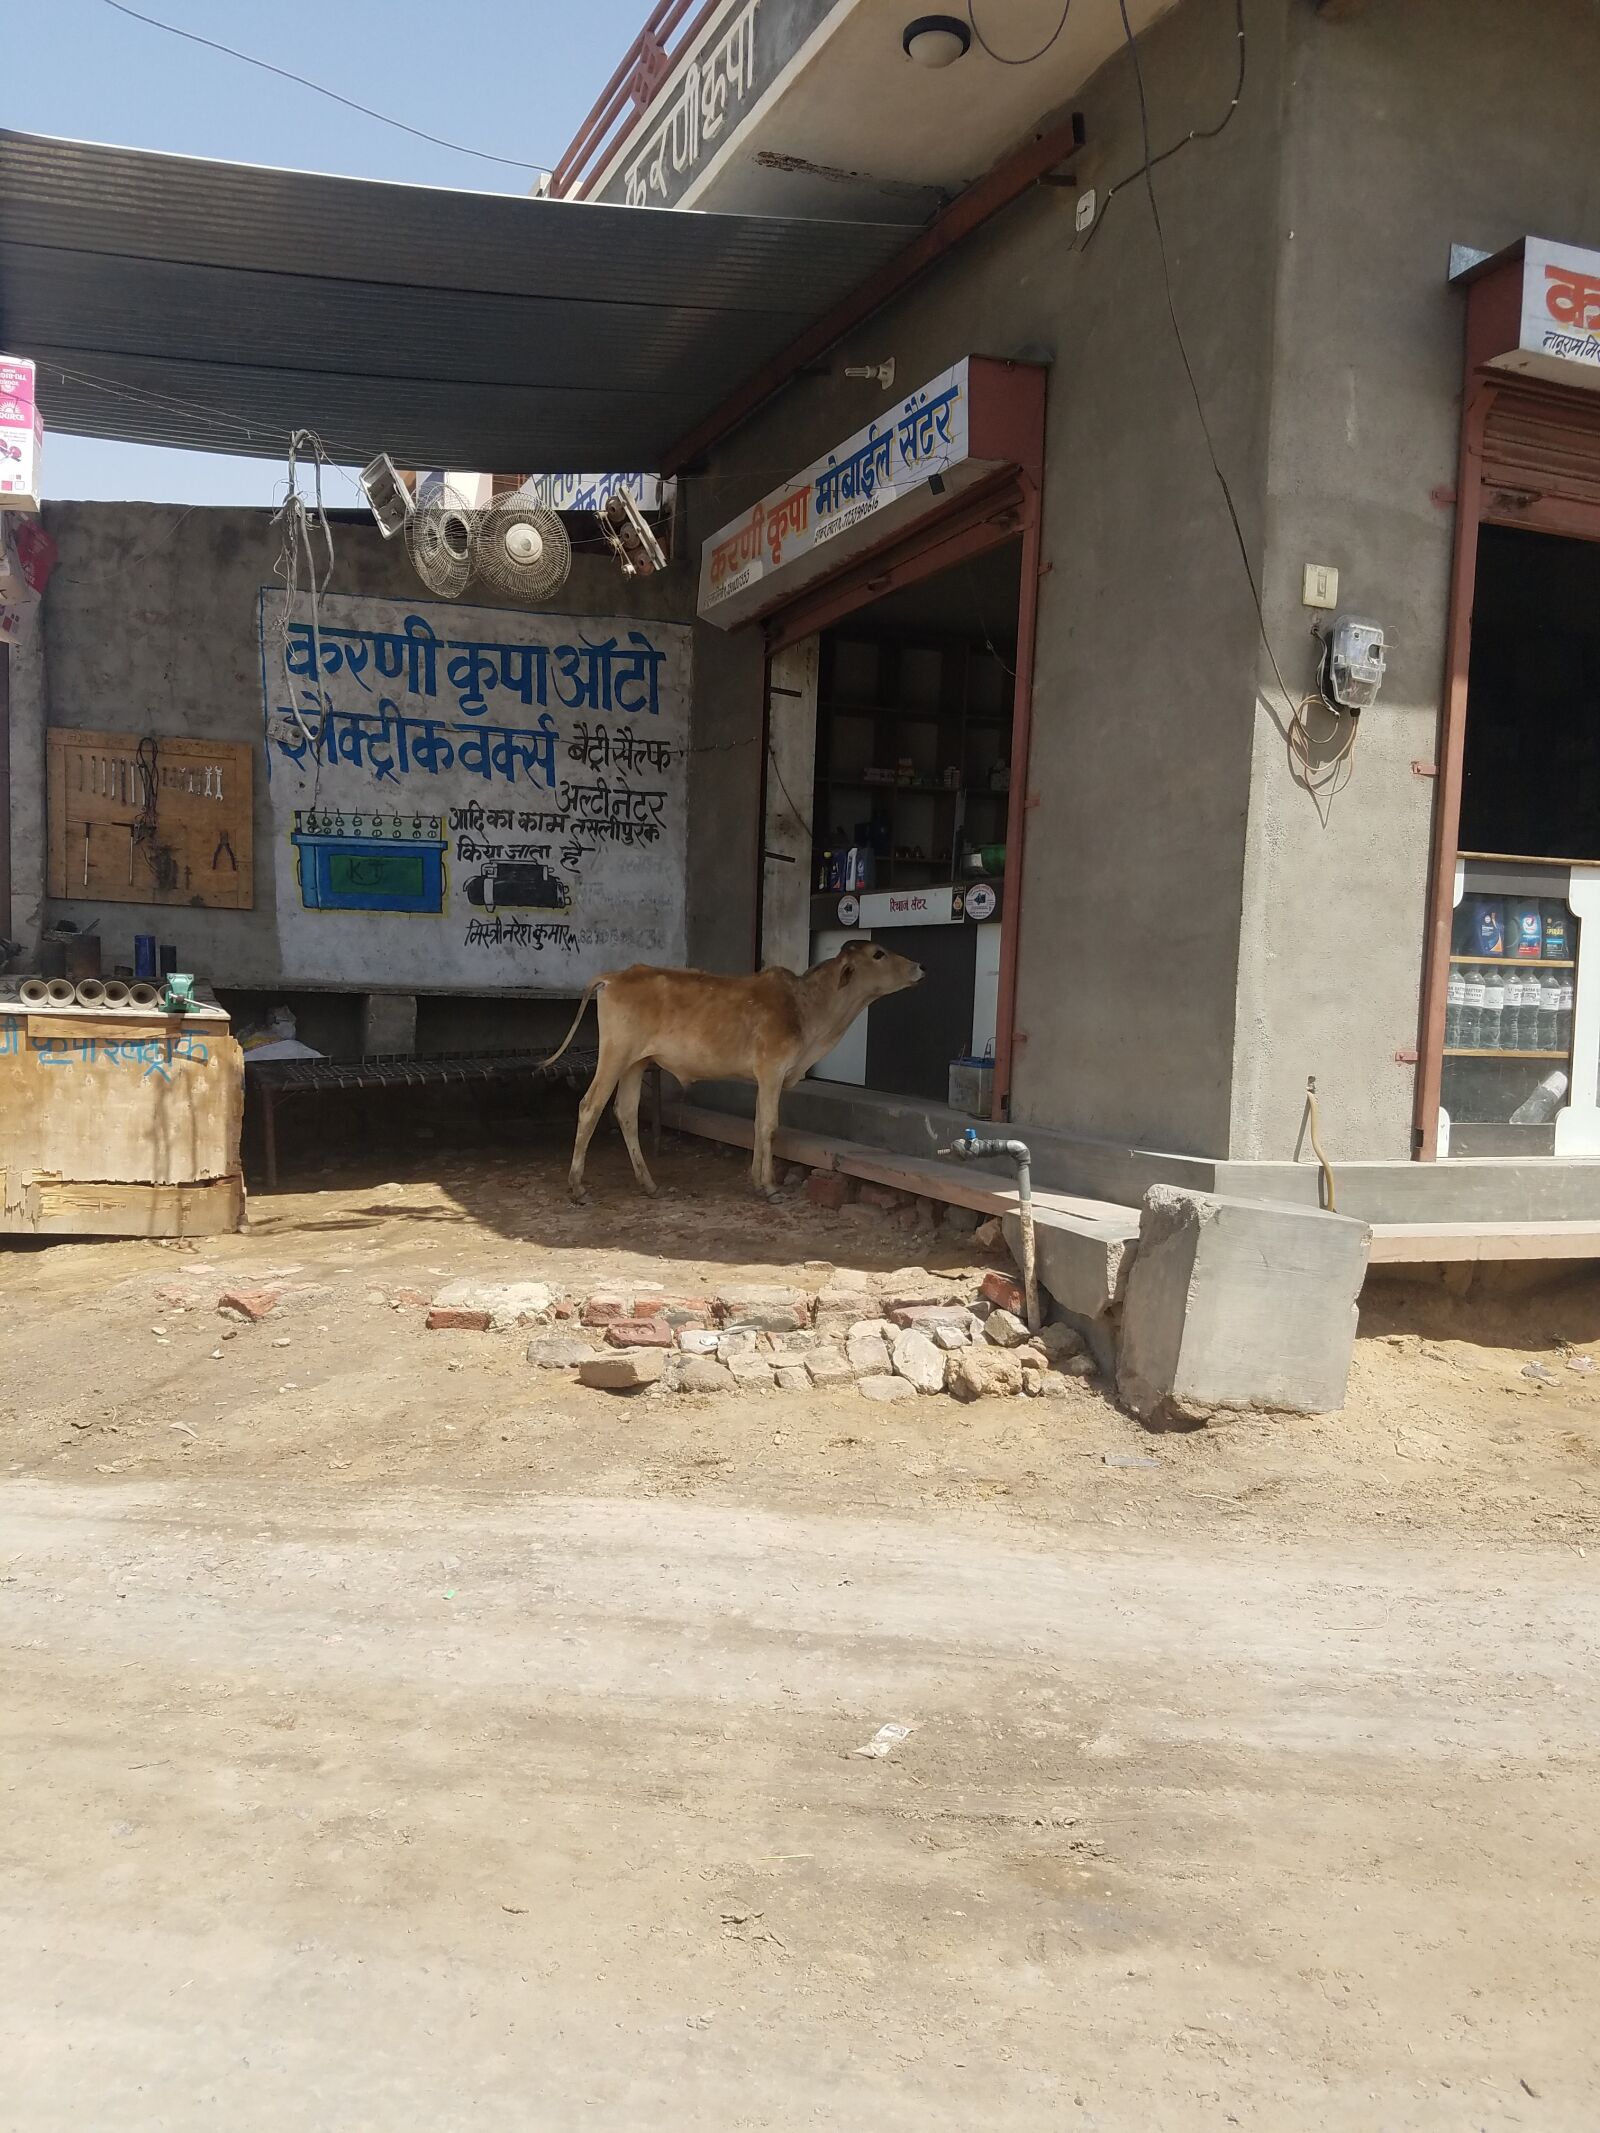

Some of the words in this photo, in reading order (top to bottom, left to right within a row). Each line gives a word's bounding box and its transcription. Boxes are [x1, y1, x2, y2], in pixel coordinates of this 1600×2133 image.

[709, 502, 765, 584] करणी
[766, 485, 811, 565] कृपा
[286, 614, 445, 697] करणी
[446, 639, 550, 717] कृपा
[551, 631, 667, 716] ऑटो
[449, 799, 489, 844] आदि
[487, 808, 515, 831] का
[517, 810, 570, 834] काम
[457, 834, 504, 863] किया
[505, 843, 552, 860] जाता
[559, 840, 596, 873] है
[502, 914, 534, 948] नरेश
[532, 923, 571, 952] कुमार
